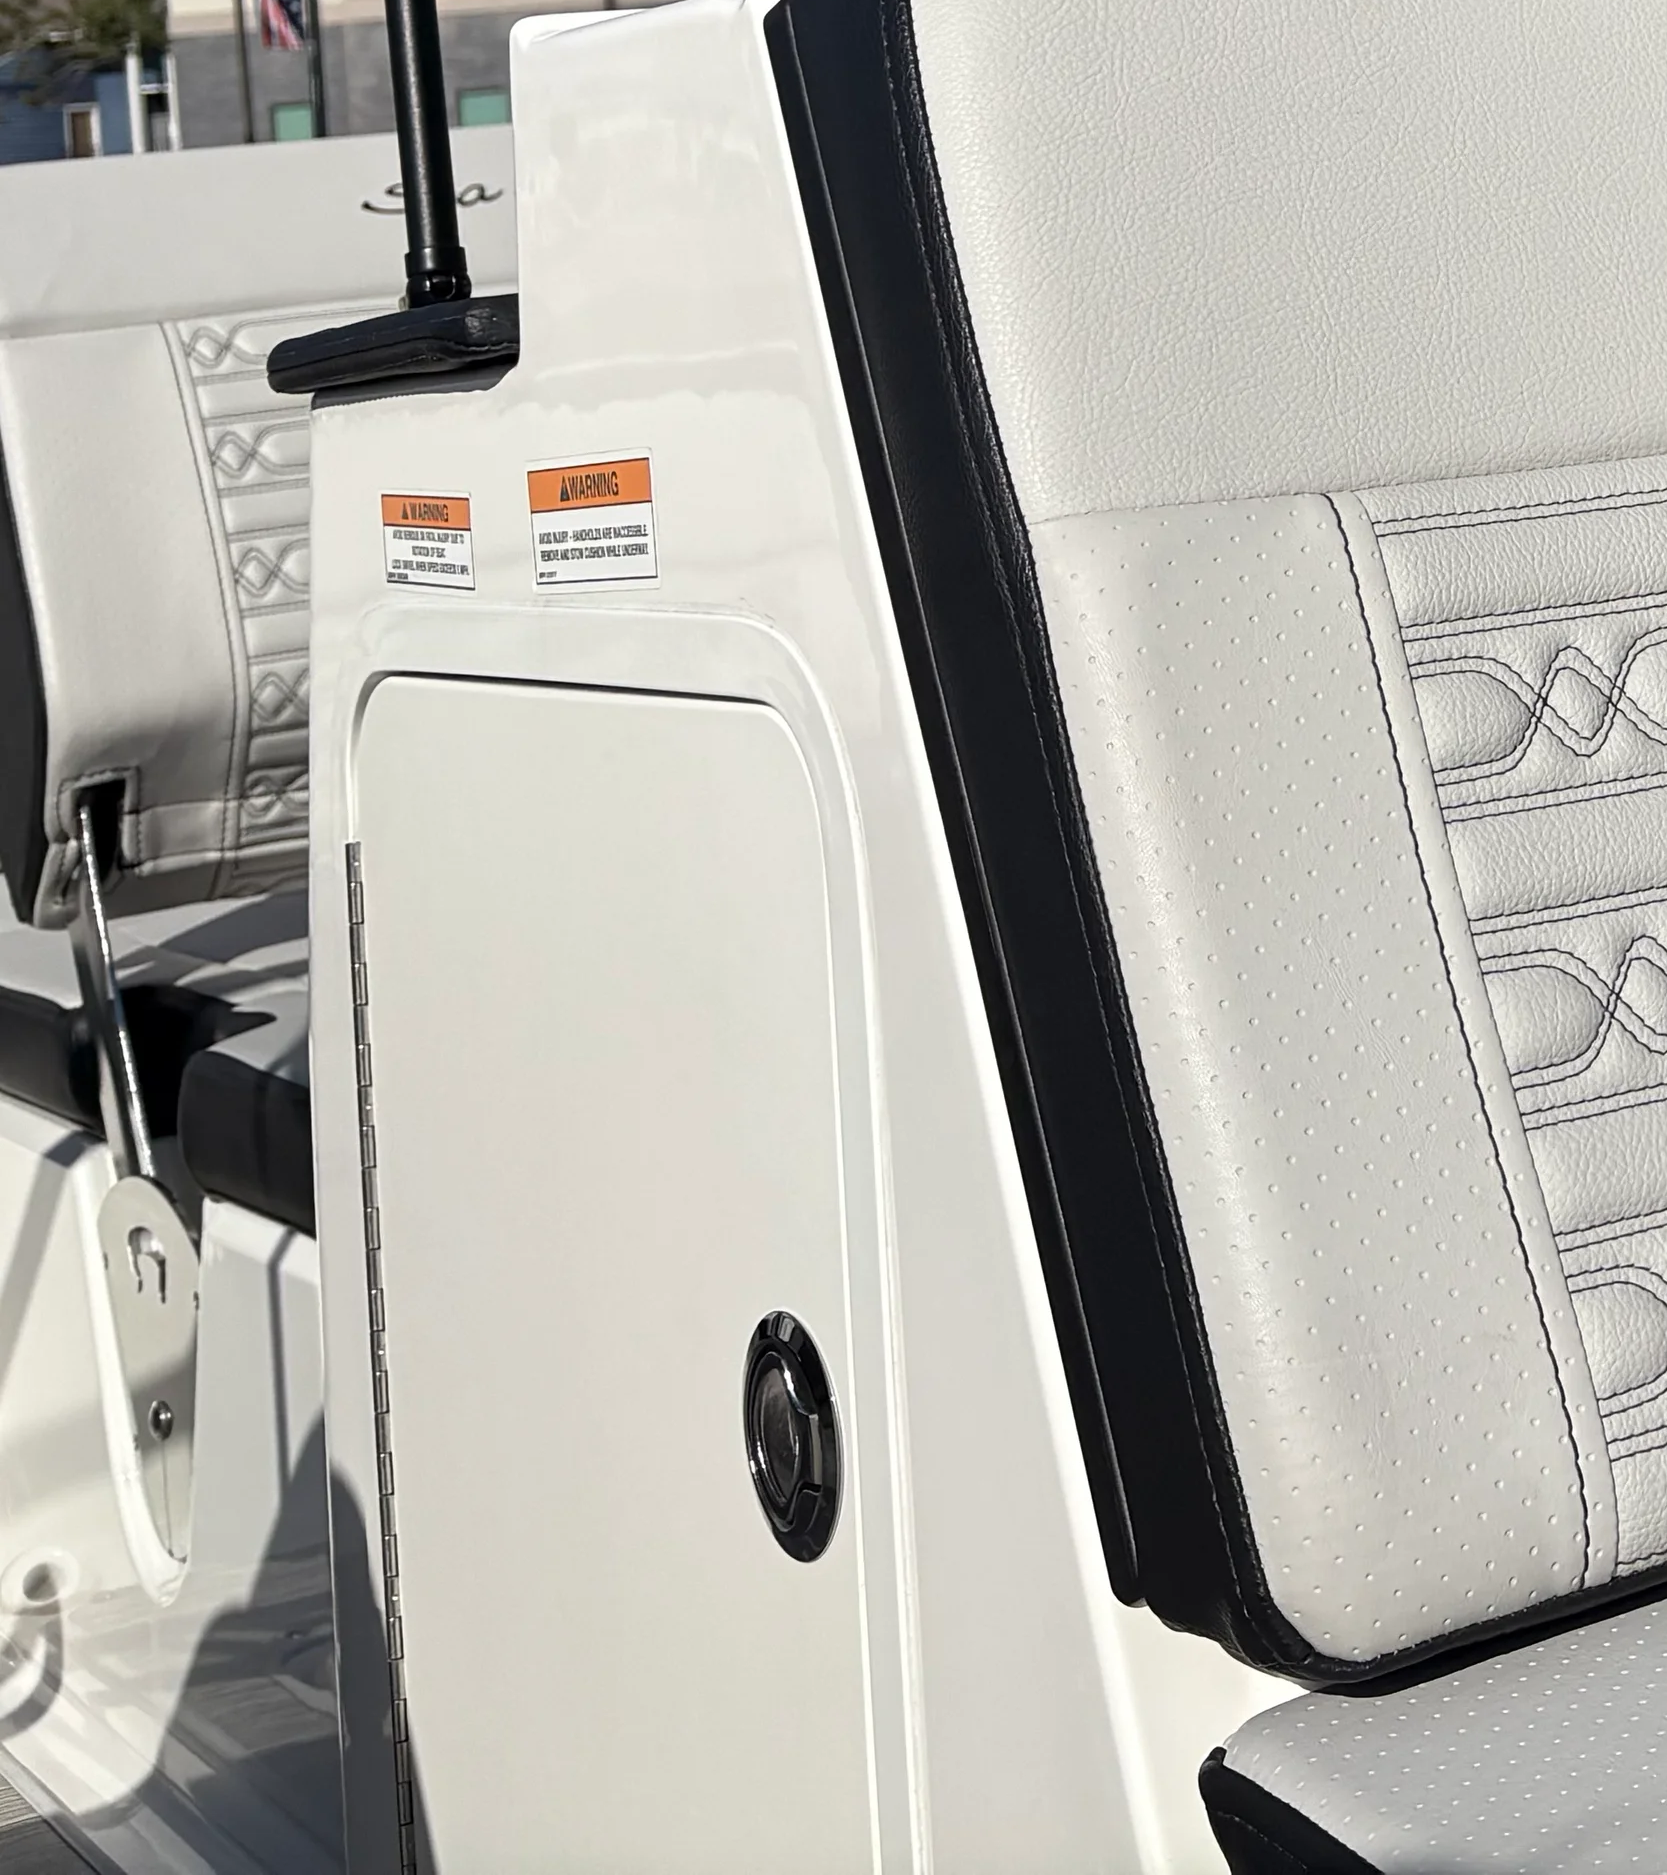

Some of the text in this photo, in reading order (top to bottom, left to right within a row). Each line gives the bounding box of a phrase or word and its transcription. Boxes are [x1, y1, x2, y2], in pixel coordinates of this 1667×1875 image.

[361, 182, 504, 215] Sa
[569, 471, 619, 501] WARNING
[409, 502, 449, 523] WARNING
